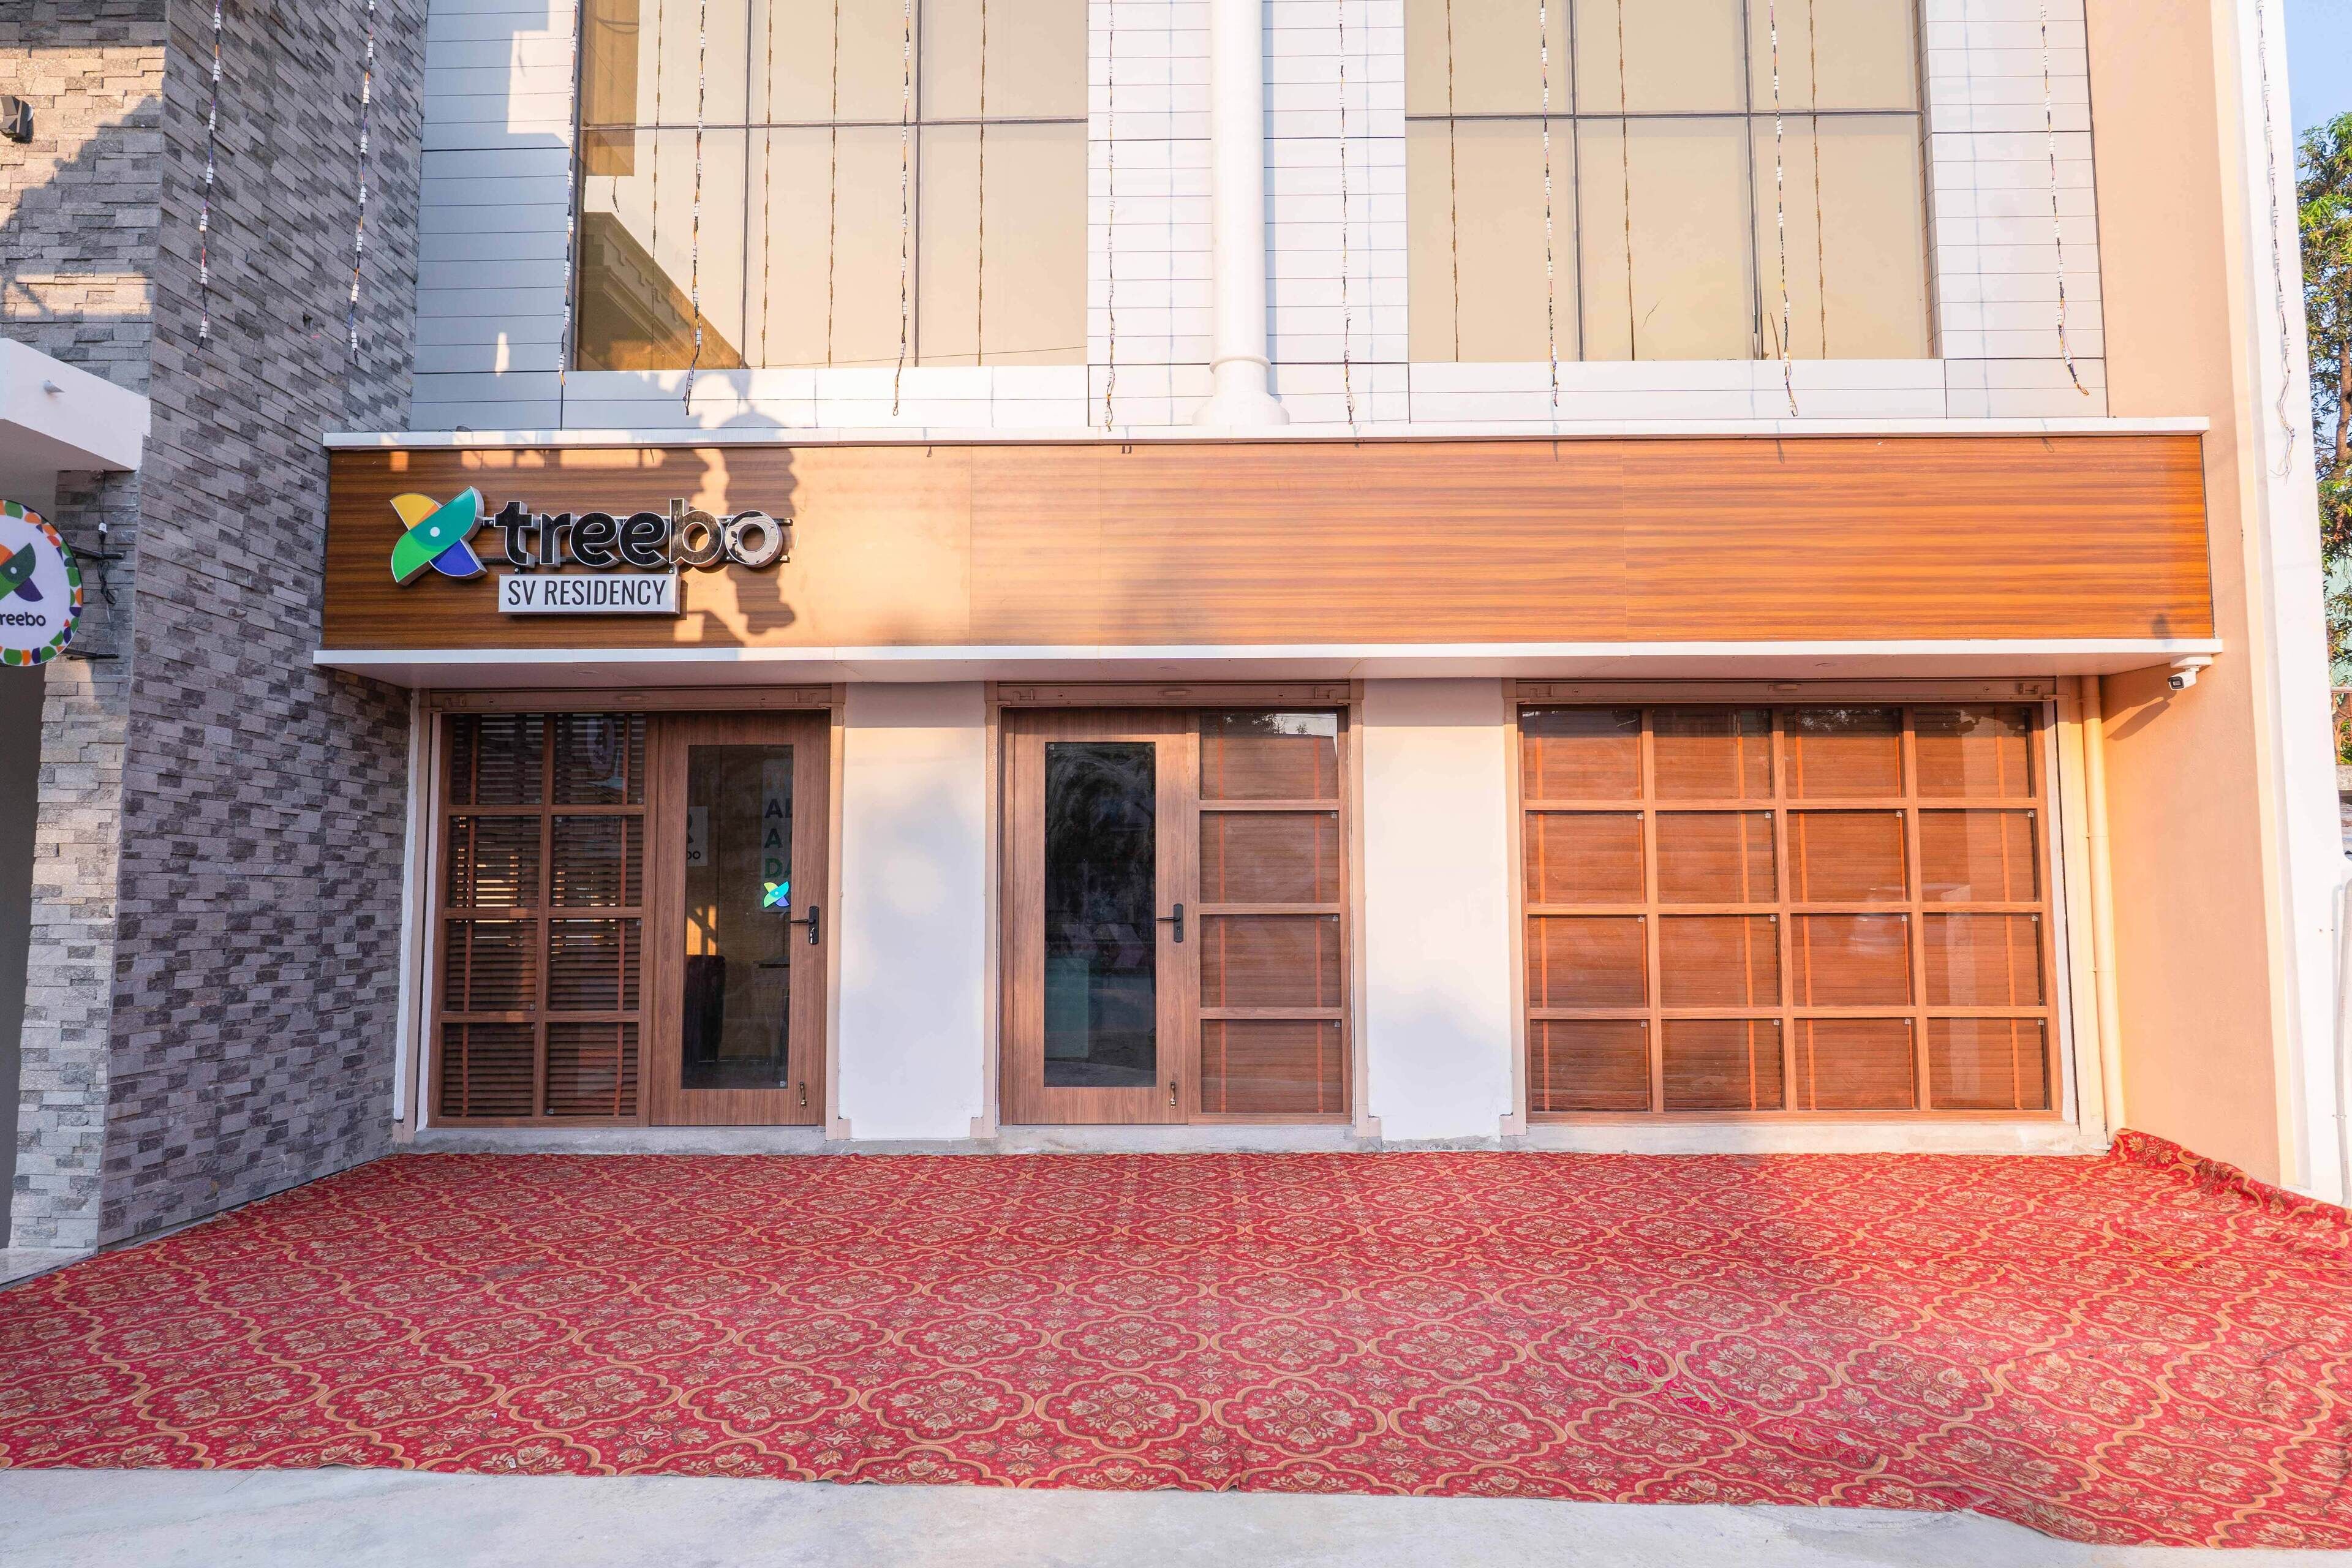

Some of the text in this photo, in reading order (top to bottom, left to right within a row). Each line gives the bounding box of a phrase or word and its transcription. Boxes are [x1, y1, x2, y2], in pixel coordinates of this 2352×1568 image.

[494, 498, 783, 568] treebo
[508, 579, 666, 605] SV RESIDENCY
[0, 611, 47, 627] reebo
